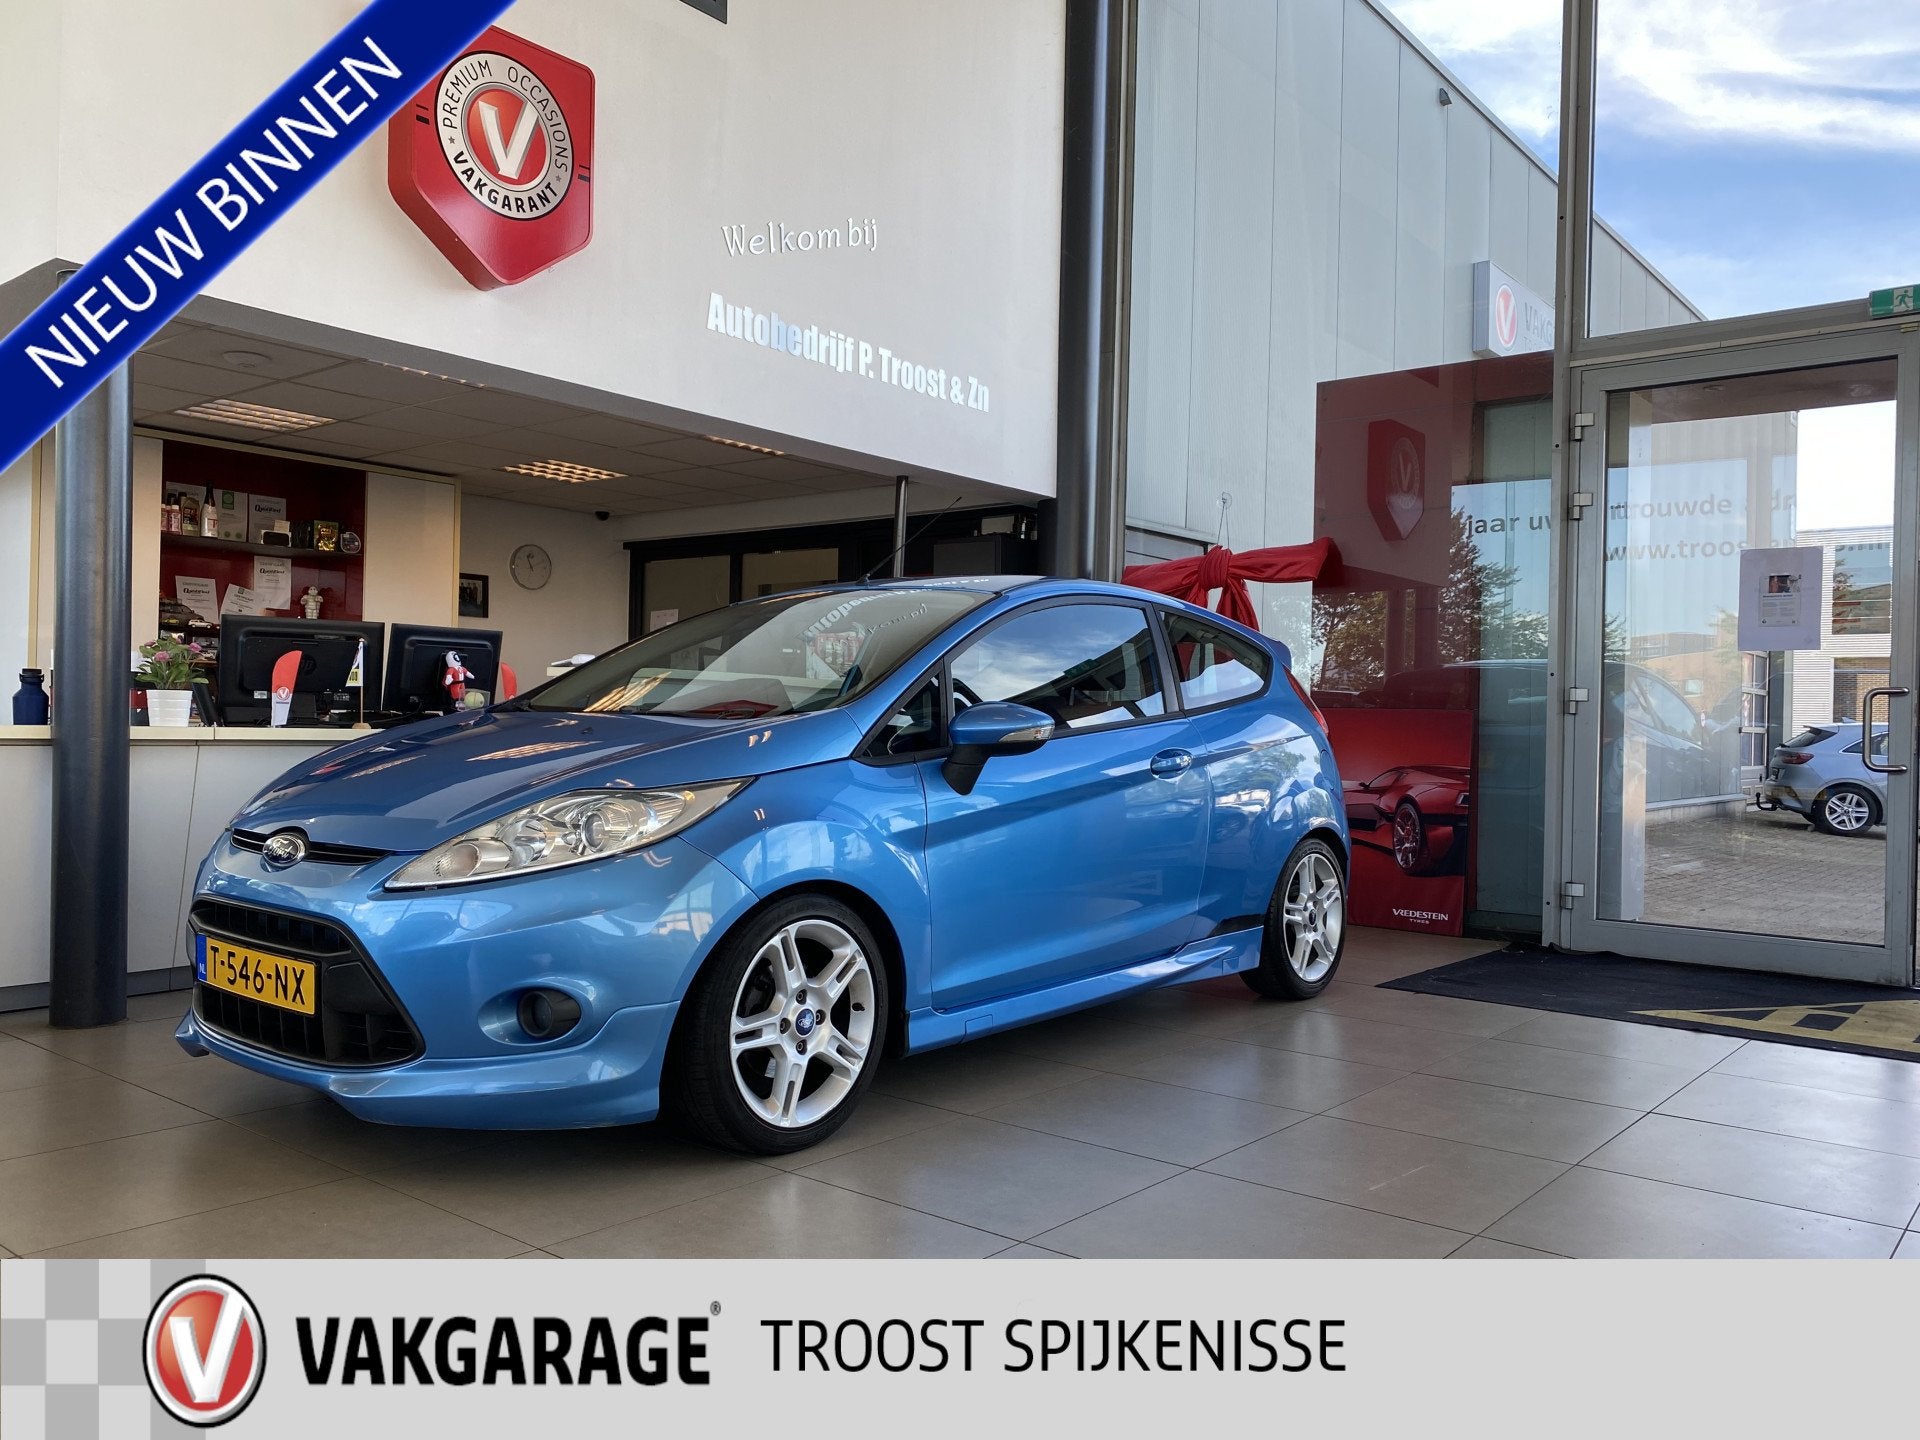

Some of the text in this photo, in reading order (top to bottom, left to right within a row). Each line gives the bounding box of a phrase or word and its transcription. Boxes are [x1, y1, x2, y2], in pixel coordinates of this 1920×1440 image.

[443, 60, 569, 173] PREMIUM OCCASIONS
[453, 150, 558, 213] VAKGARANT
[721, 218, 878, 257] Welkom bij
[706, 292, 990, 413] Autobedrijf P. Troost & Zn
[1466, 515, 1520, 541] jaar
[1392, 908, 1449, 921] VREDESTEIN
[210, 945, 306, 1006] T-546-NX
